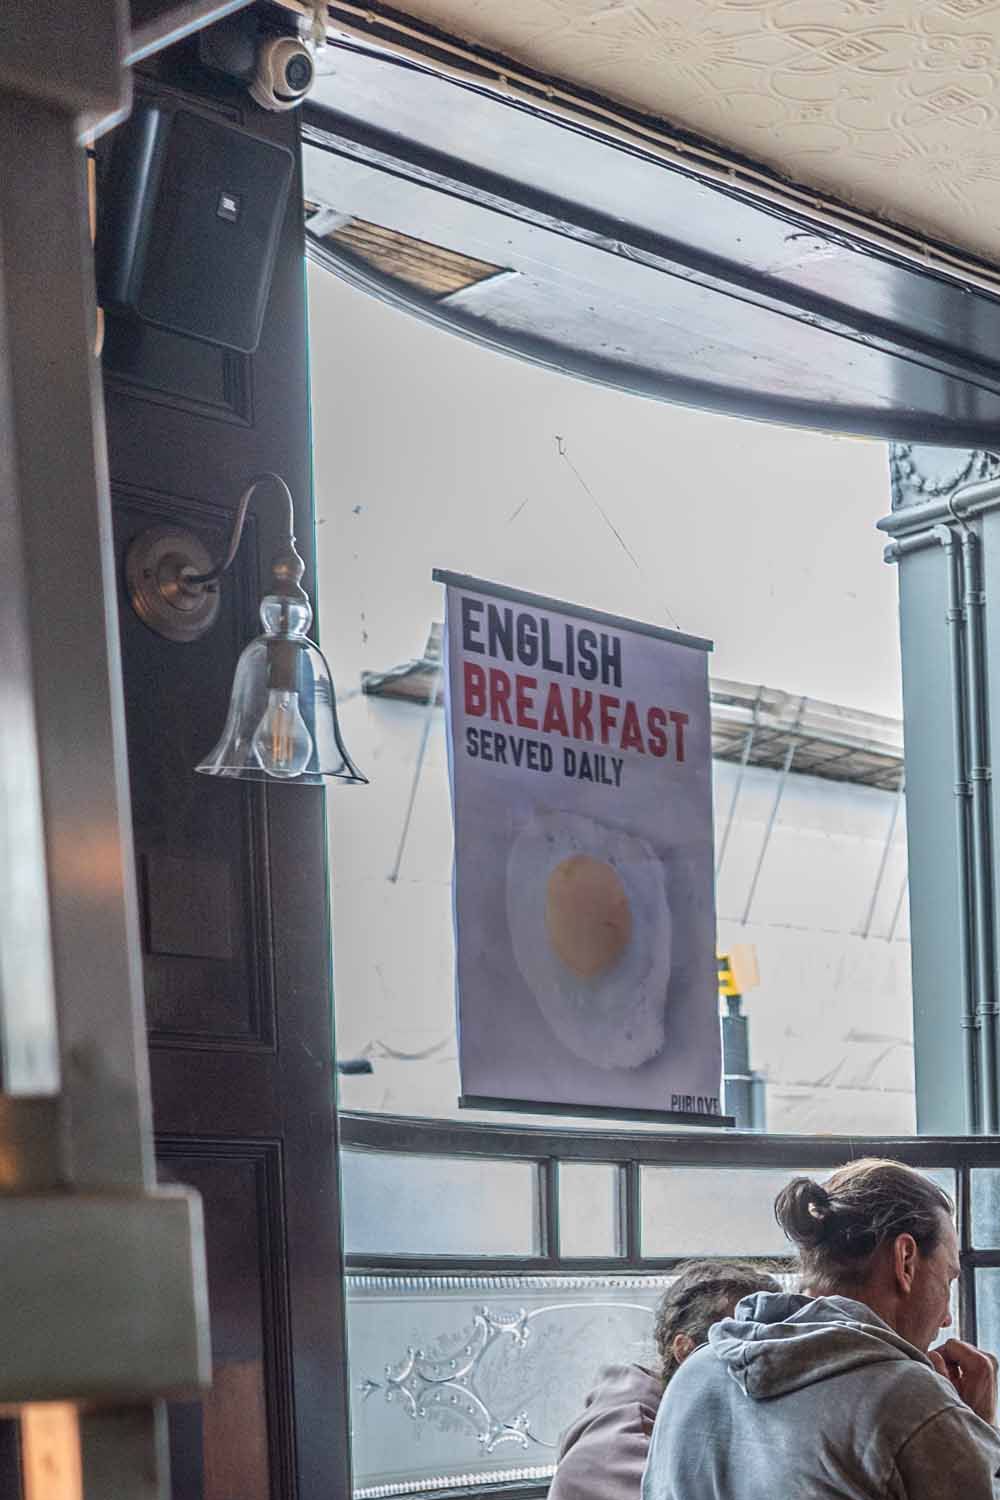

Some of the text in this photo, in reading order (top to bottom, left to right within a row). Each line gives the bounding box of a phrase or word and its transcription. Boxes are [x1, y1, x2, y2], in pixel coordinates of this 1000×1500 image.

[461, 597, 623, 688] ENGLISH
[463, 662, 689, 763] BREAKFAST
[466, 727, 624, 787] SERVED DAILY
